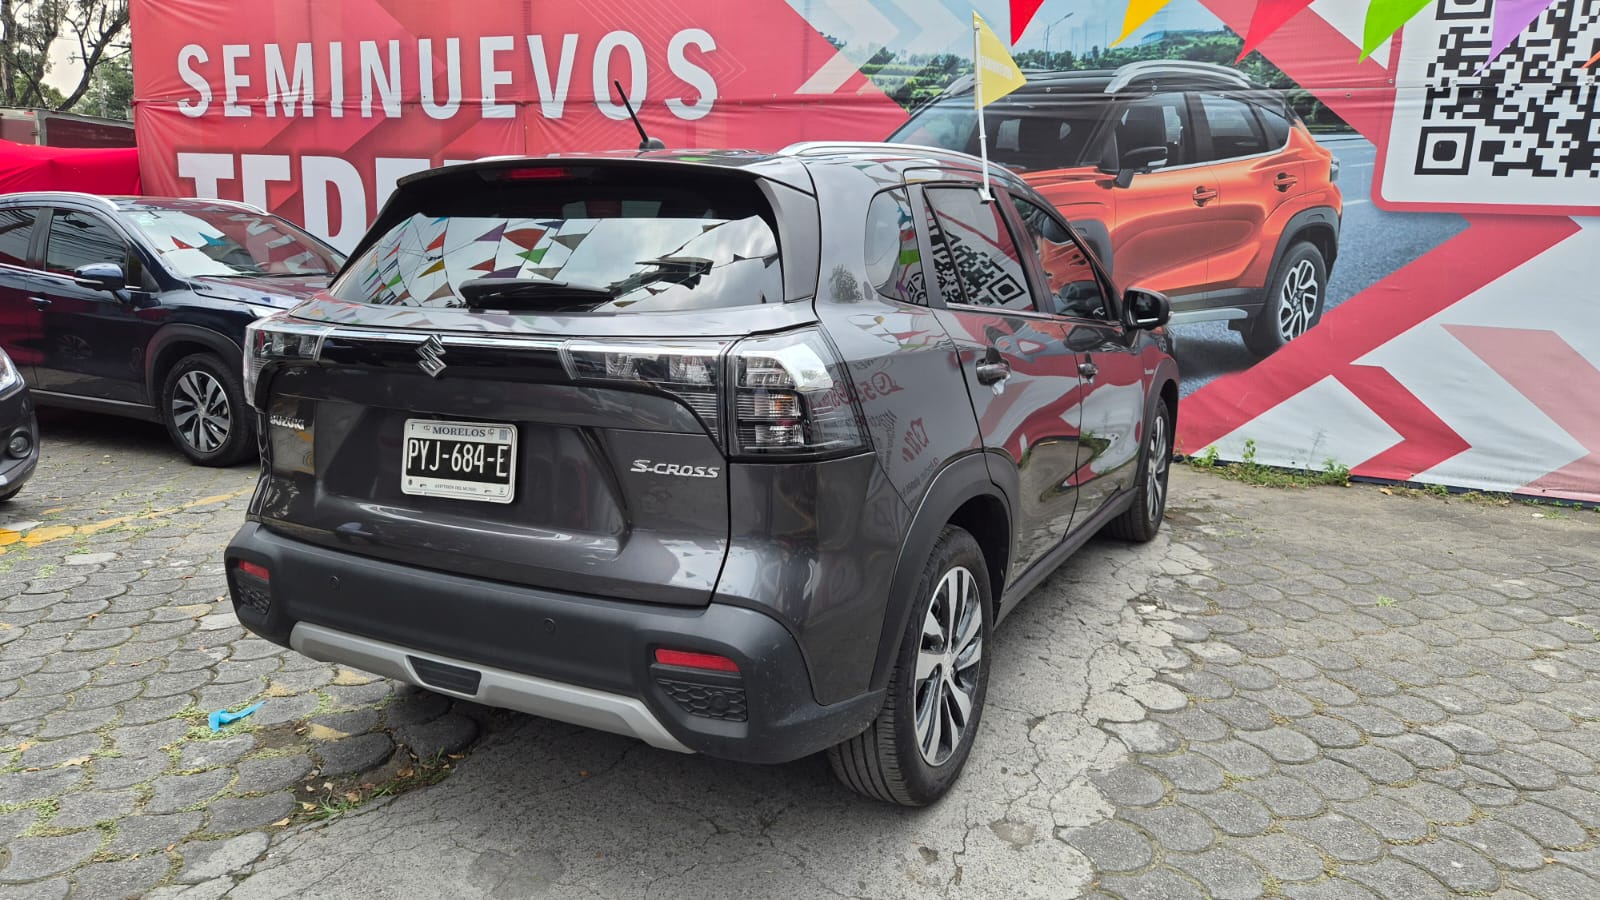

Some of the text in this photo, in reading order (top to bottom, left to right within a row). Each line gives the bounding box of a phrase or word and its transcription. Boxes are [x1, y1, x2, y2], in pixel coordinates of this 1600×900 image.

[177, 29, 717, 121] SEMINUEVOS
[432, 426, 486, 438] MORELOS
[407, 439, 510, 477] PYJ-684-E
[630, 459, 720, 478] S-CROSS
